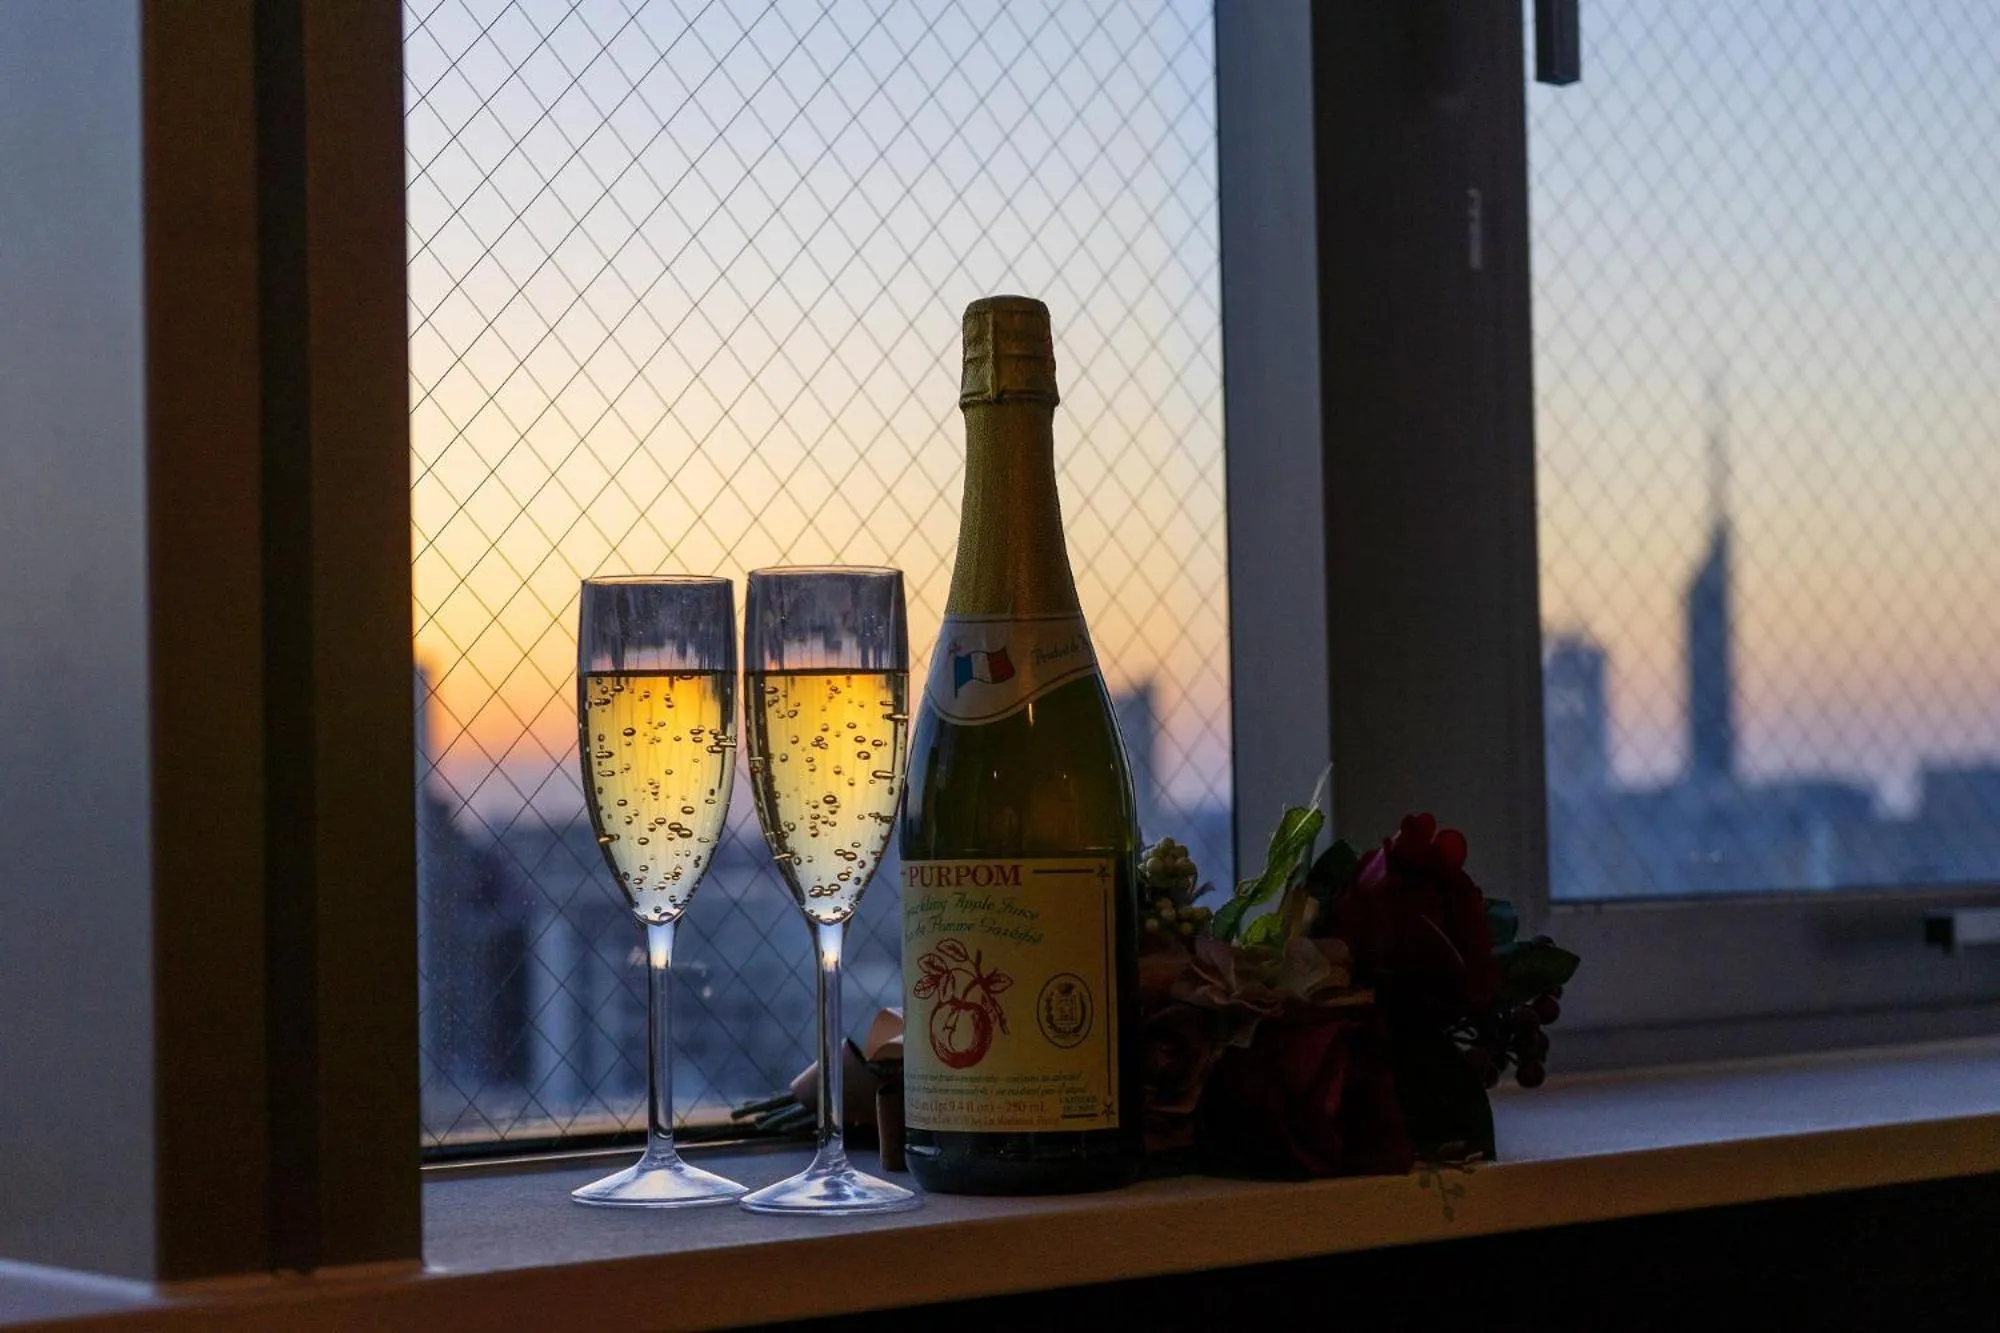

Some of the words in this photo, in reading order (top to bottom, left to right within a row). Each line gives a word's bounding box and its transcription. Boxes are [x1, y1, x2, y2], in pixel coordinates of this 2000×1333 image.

[908, 864, 1024, 888] PURPOM
[952, 891, 995, 914] Apple
[929, 915, 975, 934] Pomme
